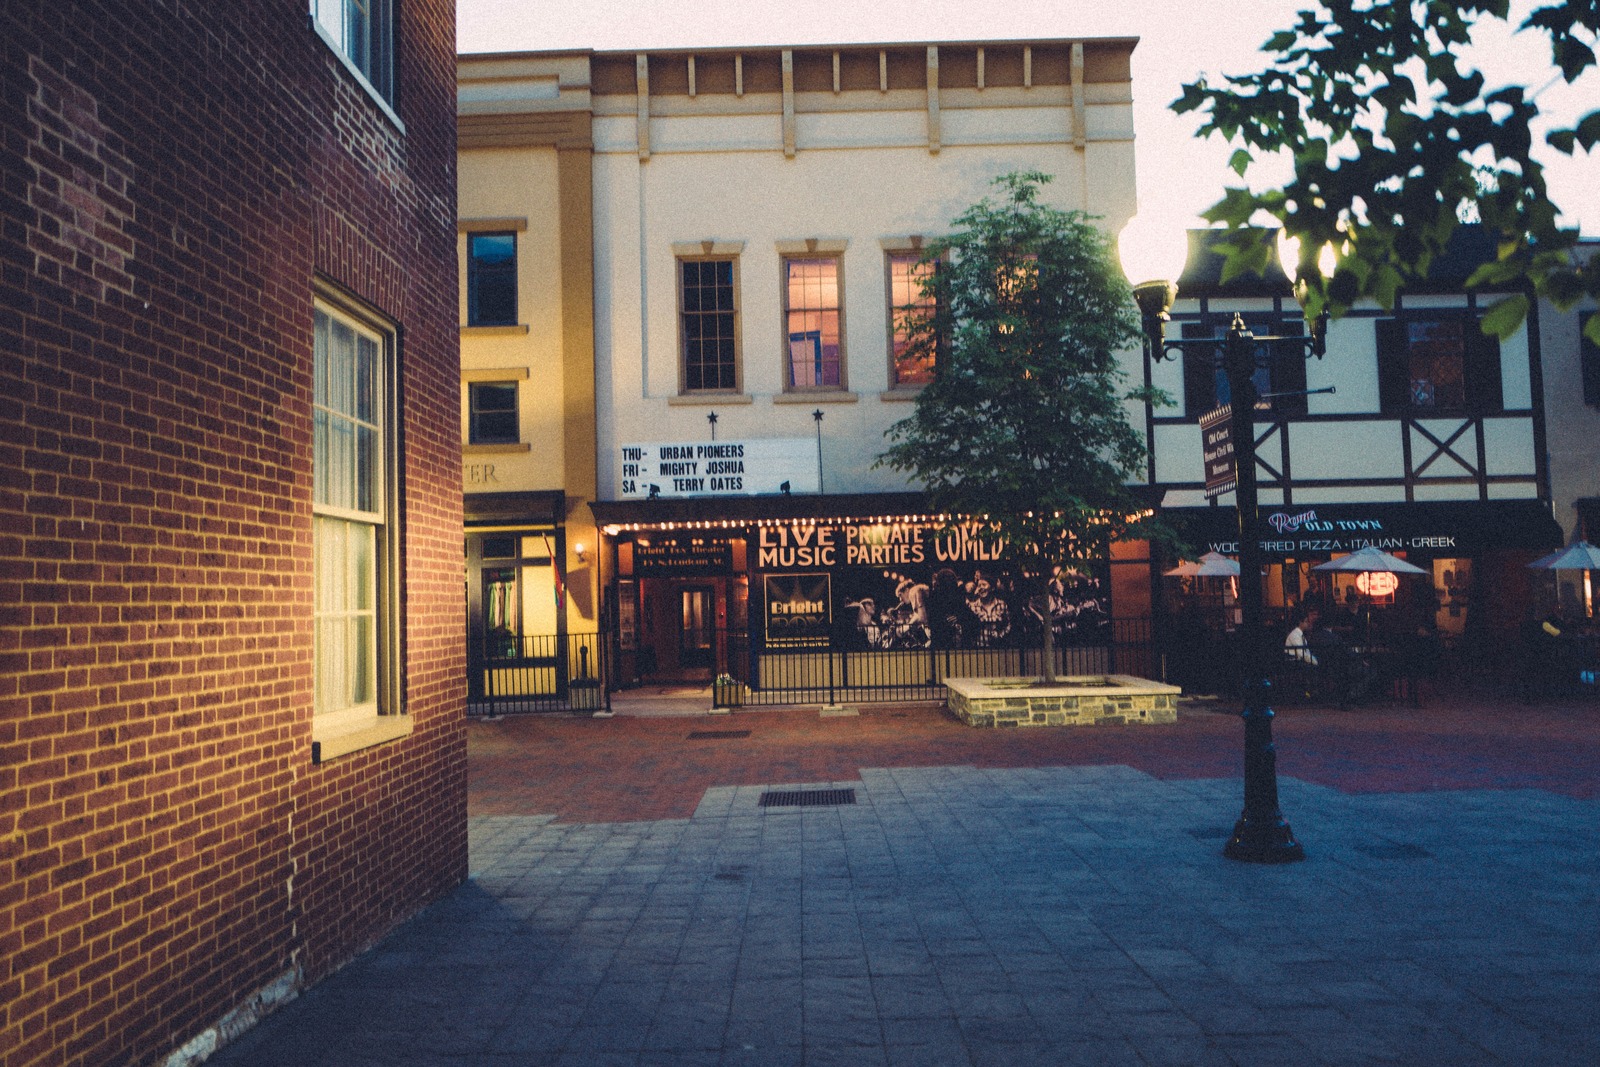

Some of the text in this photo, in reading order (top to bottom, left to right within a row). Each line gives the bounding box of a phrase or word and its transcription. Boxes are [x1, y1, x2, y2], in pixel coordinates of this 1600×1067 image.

[660, 447, 693, 459] URBAN
[697, 445, 744, 458] PIONEERS
[465, 464, 499, 483] ER
[660, 462, 697, 476] MIGHTY
[706, 461, 745, 475] JOSHUA
[673, 478, 704, 491] TERRY
[711, 477, 742, 491] OATES
[1268, 510, 1317, 534] Roma
[1305, 520, 1383, 531] OLD TOWN
[759, 526, 835, 547] LIVE
[847, 525, 924, 544] PRIVATE
[935, 523, 1010, 561] COMED
[1209, 542, 1240, 552] WOO
[1299, 540, 1342, 550] PIZZA
[1351, 538, 1403, 549] ITALIAN
[1412, 536, 1455, 548] GREEK
[759, 546, 836, 567] MUSIC
[847, 545, 925, 564] PARTIES
[771, 600, 825, 614] Bright
